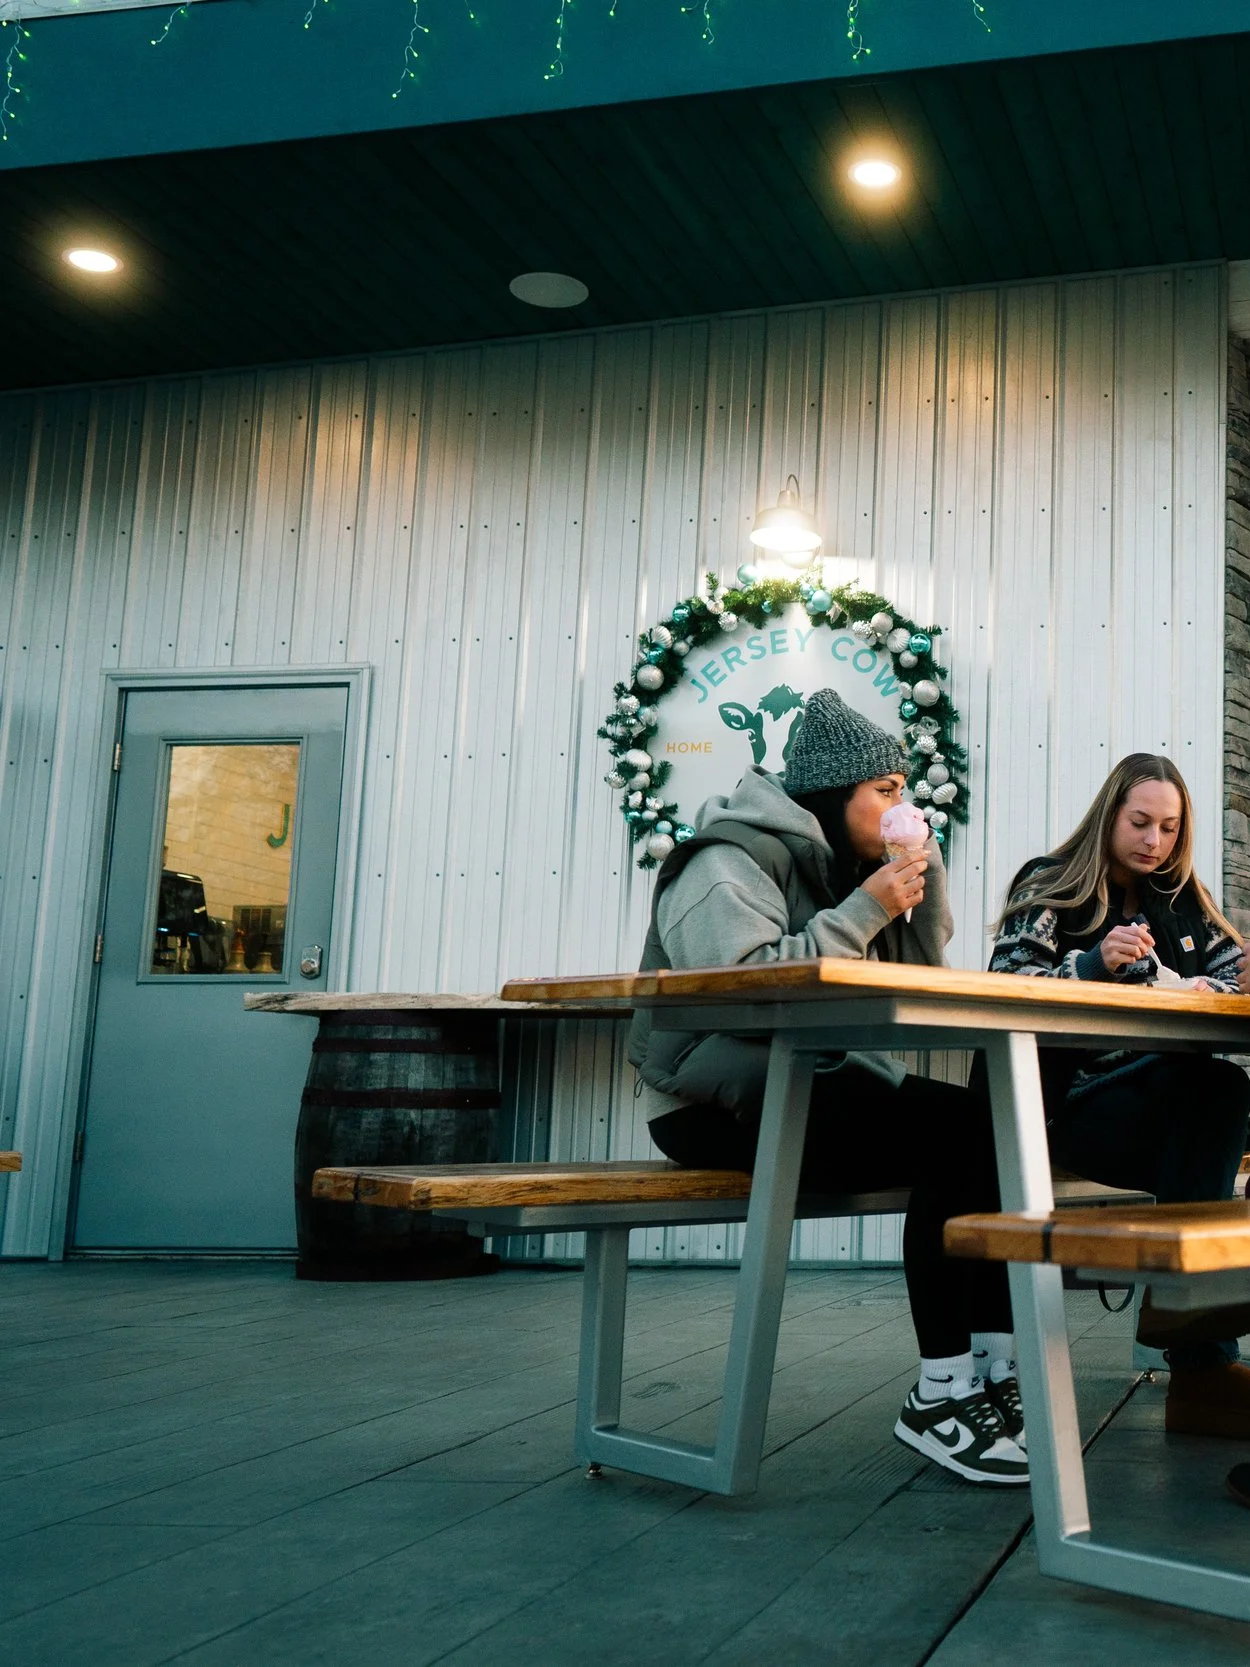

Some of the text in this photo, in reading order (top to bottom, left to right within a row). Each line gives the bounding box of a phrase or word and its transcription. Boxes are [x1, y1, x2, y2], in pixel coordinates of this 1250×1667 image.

[690, 628, 899, 704] JERSEY COW
[666, 742, 713, 753] HOME
